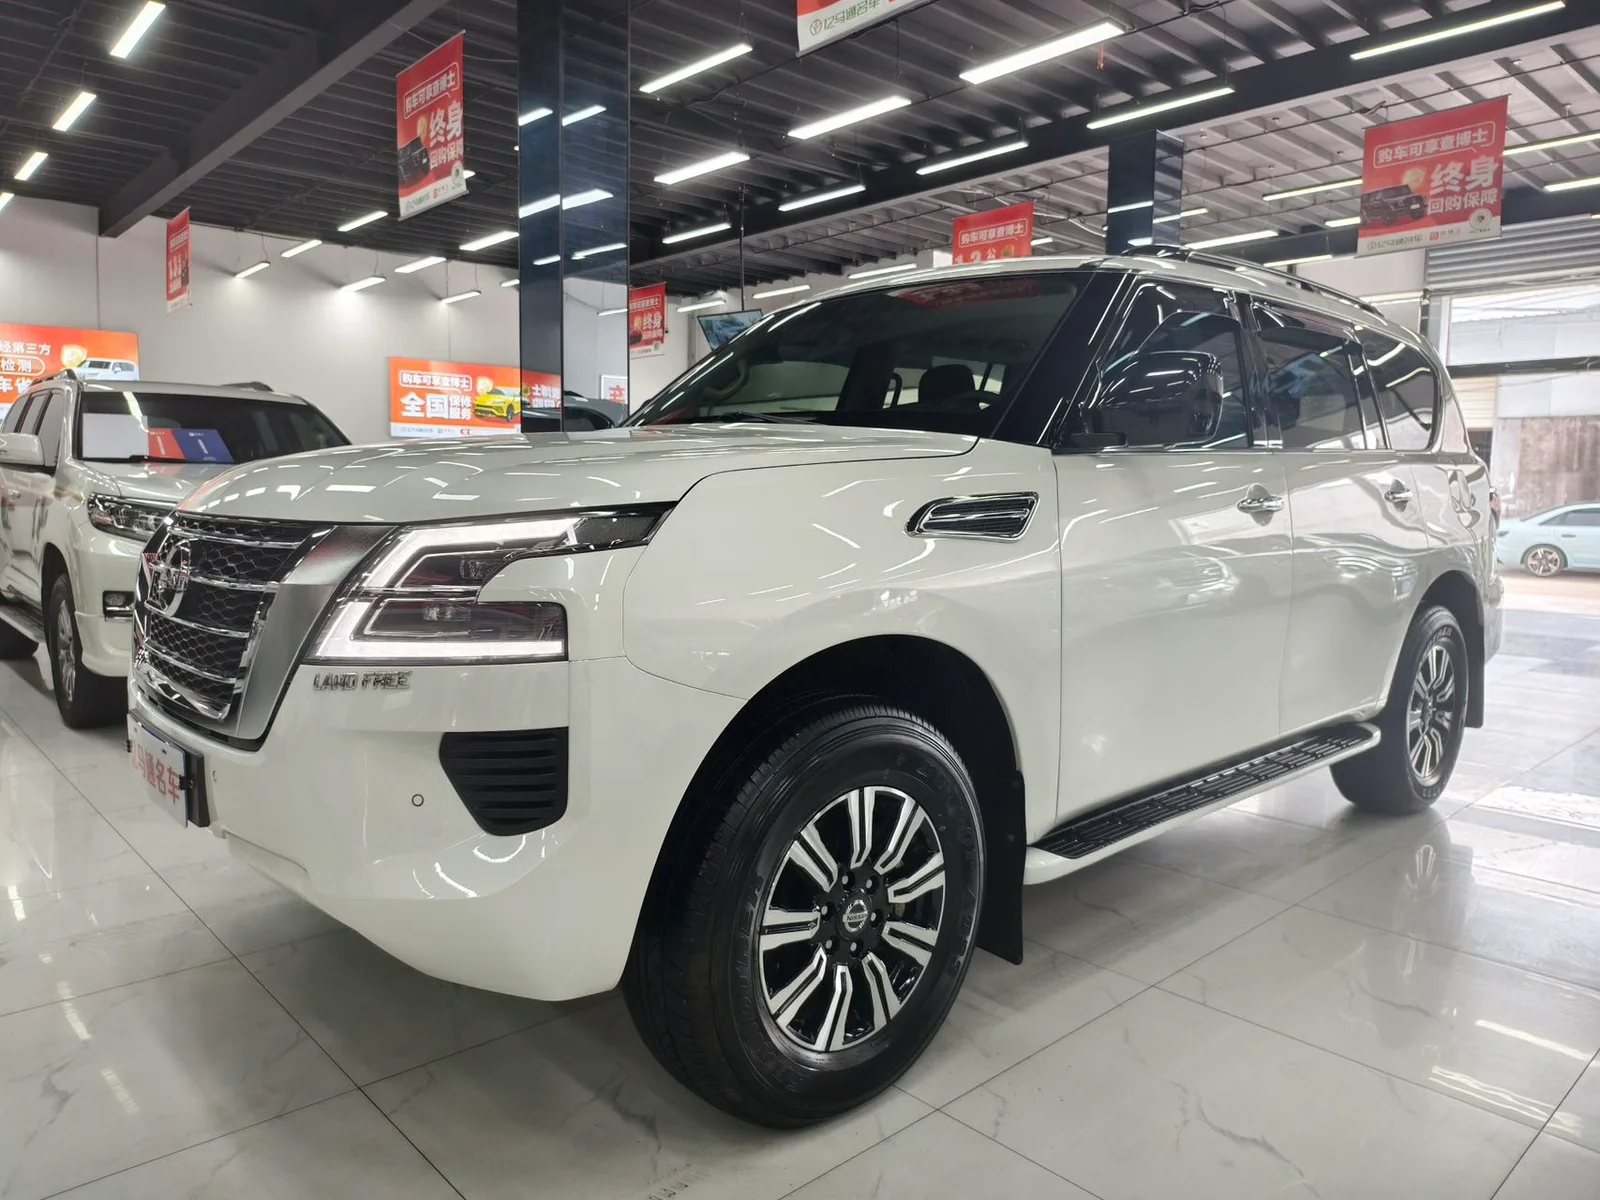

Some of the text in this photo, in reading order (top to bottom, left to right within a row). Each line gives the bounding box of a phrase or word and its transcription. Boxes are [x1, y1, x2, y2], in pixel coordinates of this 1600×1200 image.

[429, 101, 463, 147] 终身
[1378, 128, 1488, 163] 购车可享查博士
[1429, 155, 1499, 195] 终身
[1427, 188, 1498, 215] 回购保障
[400, 391, 449, 418] 全国
[313, 671, 412, 691] LAND FREE
